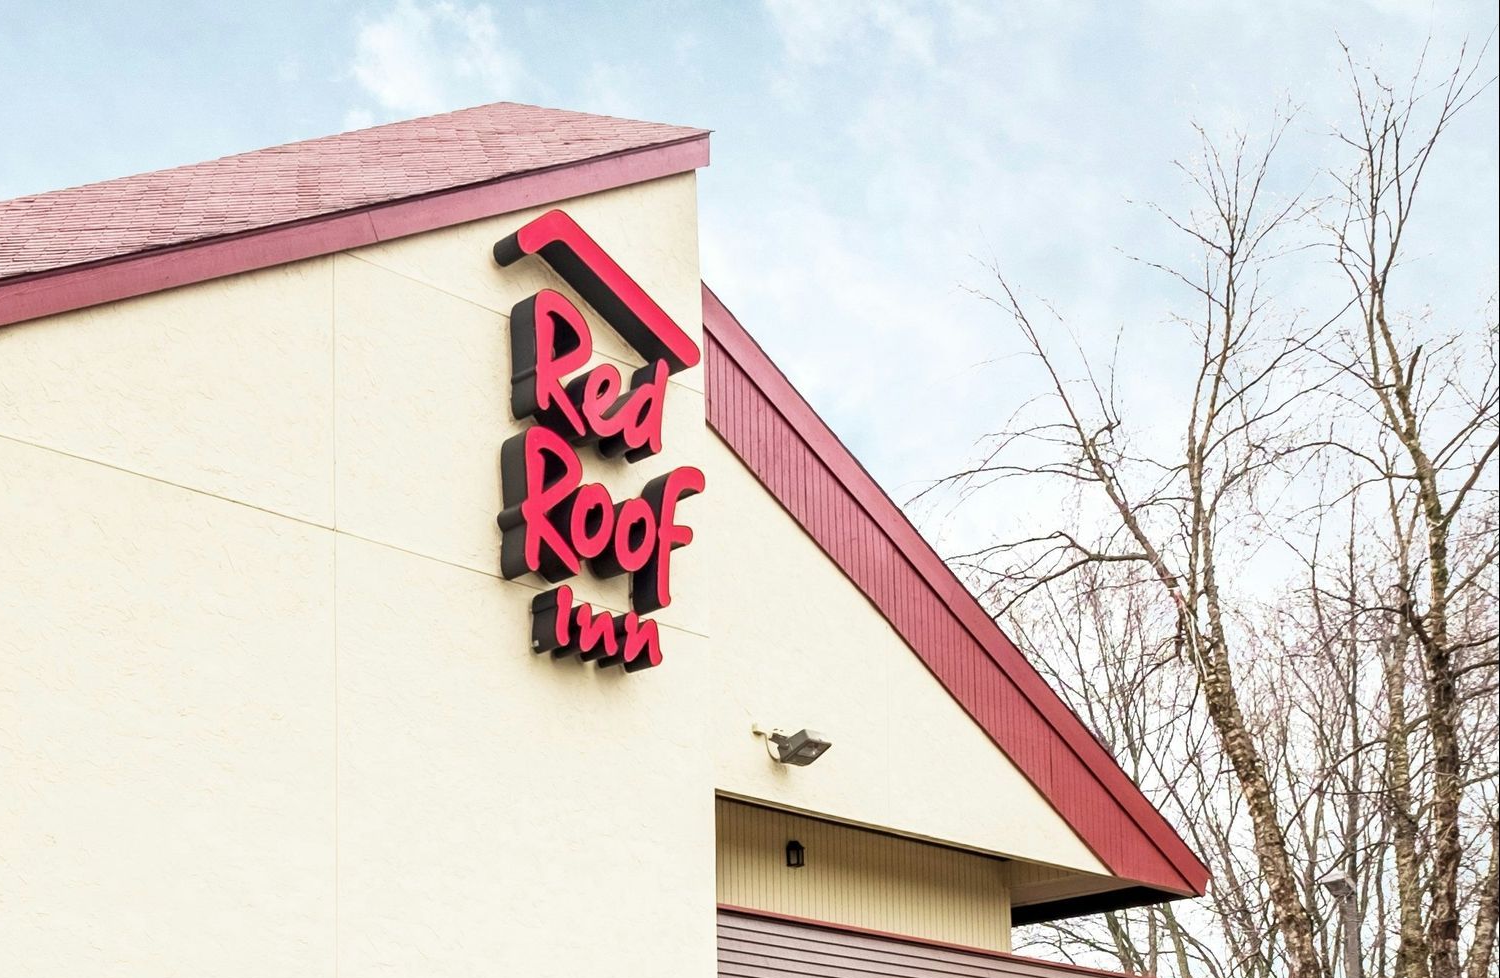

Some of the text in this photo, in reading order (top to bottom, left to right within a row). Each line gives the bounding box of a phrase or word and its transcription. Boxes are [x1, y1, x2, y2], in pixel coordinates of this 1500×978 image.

[534, 288, 670, 454] Red
[521, 425, 706, 607] Roof
[555, 584, 663, 667] Inn
